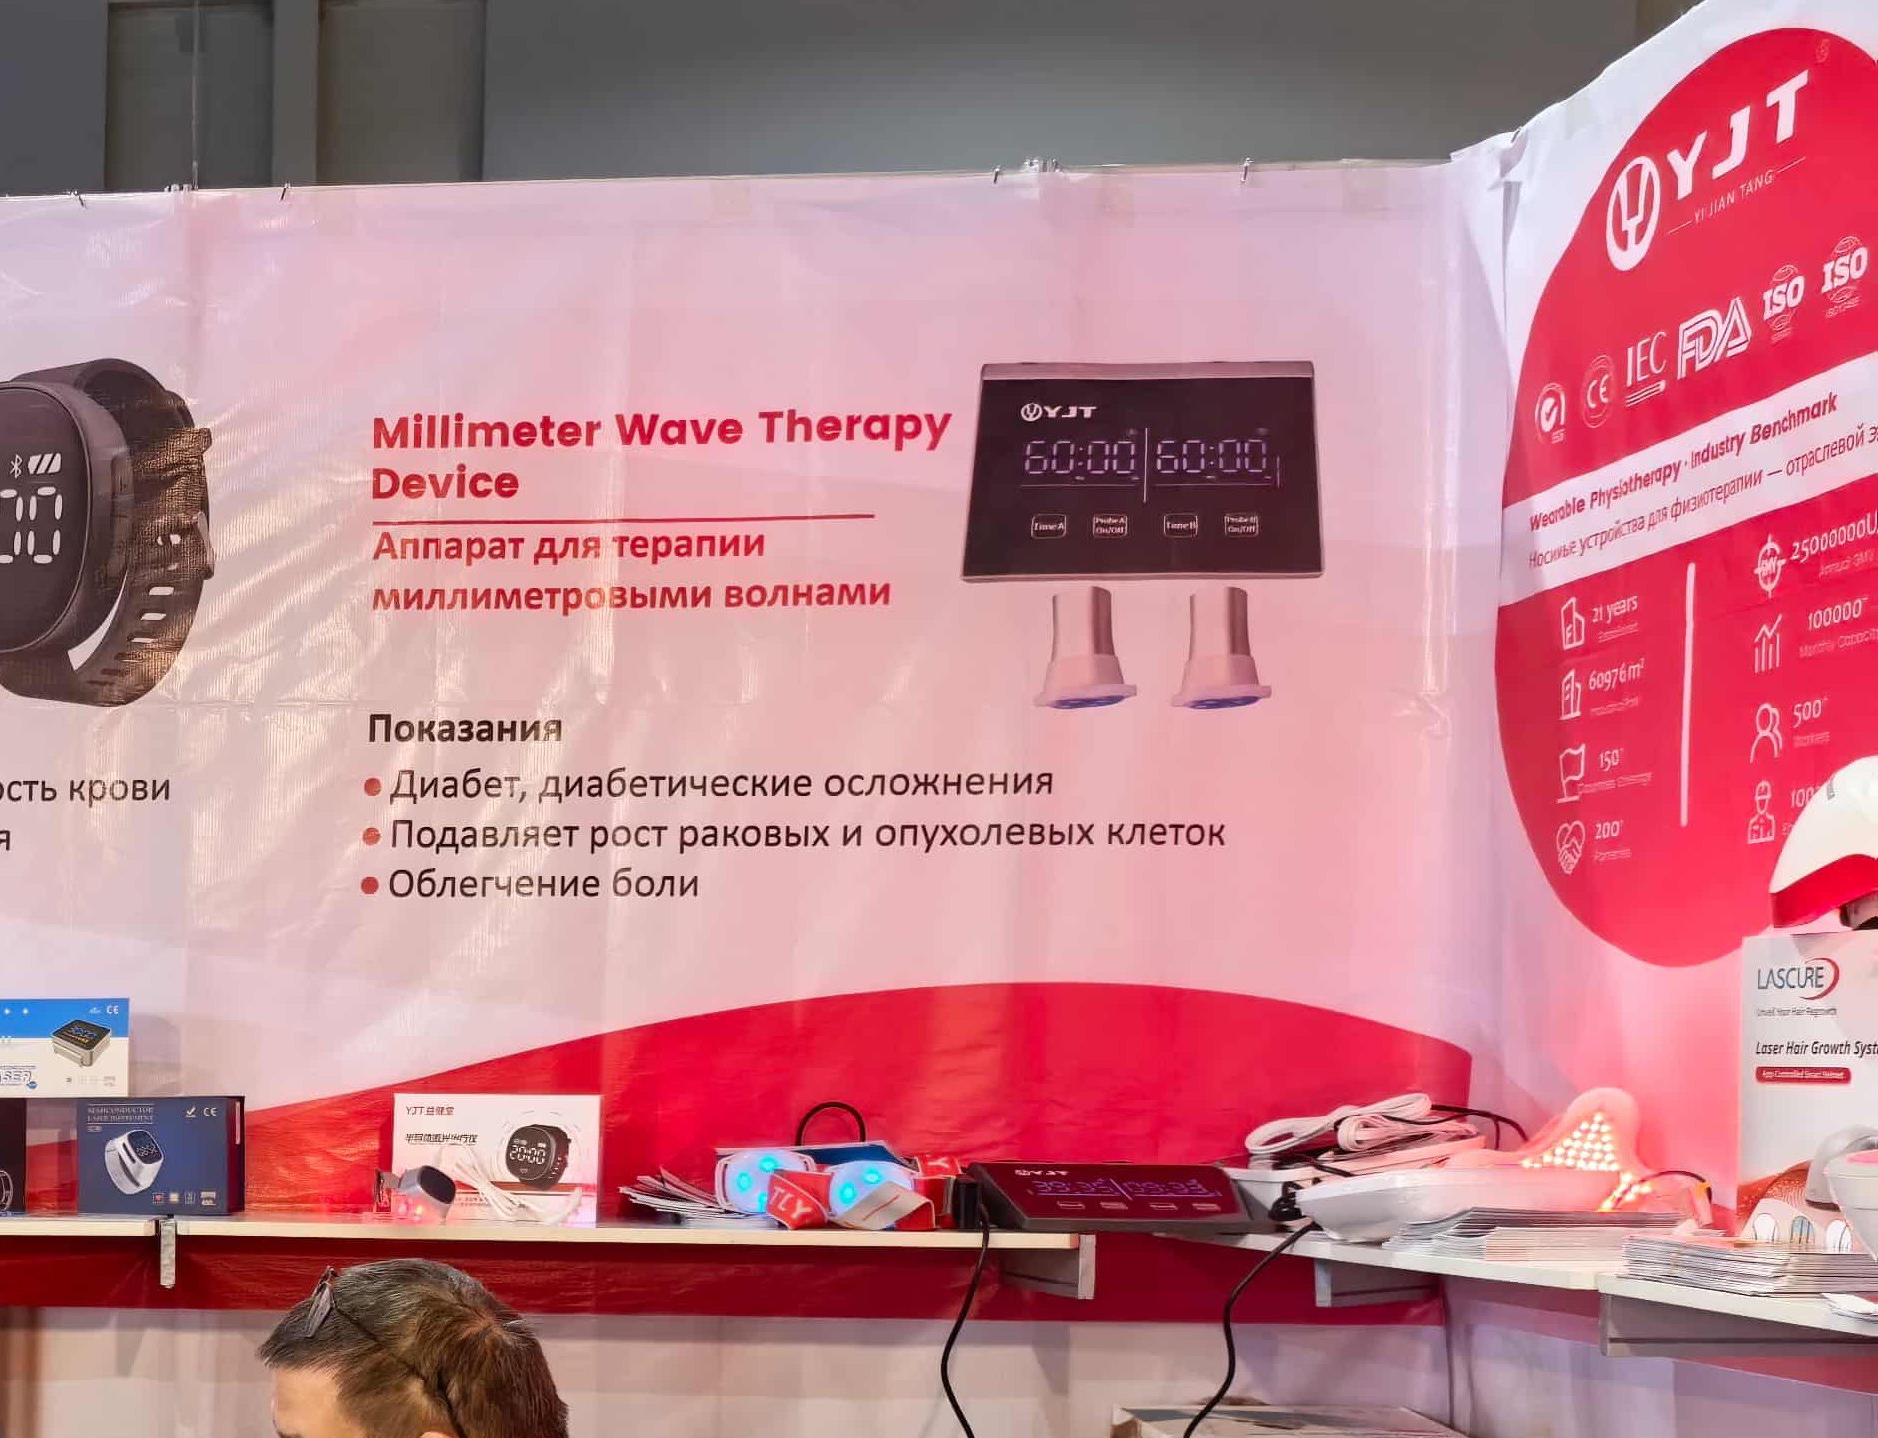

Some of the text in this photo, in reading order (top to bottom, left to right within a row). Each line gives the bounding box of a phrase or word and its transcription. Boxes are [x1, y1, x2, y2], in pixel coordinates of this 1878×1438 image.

[1666, 69, 1809, 200] YJT
[1738, 169, 1775, 200] TANG
[1627, 331, 1667, 387] IEC
[1676, 296, 1753, 381] FDA
[1762, 275, 1805, 321] ISO
[1822, 246, 1868, 293] ISO
[372, 406, 953, 453] Millimeter Wave Therapy
[1043, 405, 1098, 420] YJT
[1024, 438, 1267, 475] 60:00 60:00
[1530, 392, 1838, 532] Wearable Physiotherapy Industry Benchmark
[372, 464, 520, 501] Device
[372, 528, 766, 569] Аппарат для терапии
[372, 575, 892, 616] миллиметровыми волнами
[1593, 595, 1638, 624] 21 years
[368, 713, 564, 744] Показания
[68, 777, 172, 811] крови
[387, 766, 1054, 806] Диабет, диабетические осложнения
[389, 819, 1227, 855] Подавляет рост раковых и опухолевых клеток
[388, 865, 701, 900] Облегчение боли
[1757, 966, 1825, 990] LASCURE
[1755, 1041, 1878, 1059] Laser Hair Growth Syst
[203, 1107, 218, 1117] CE
